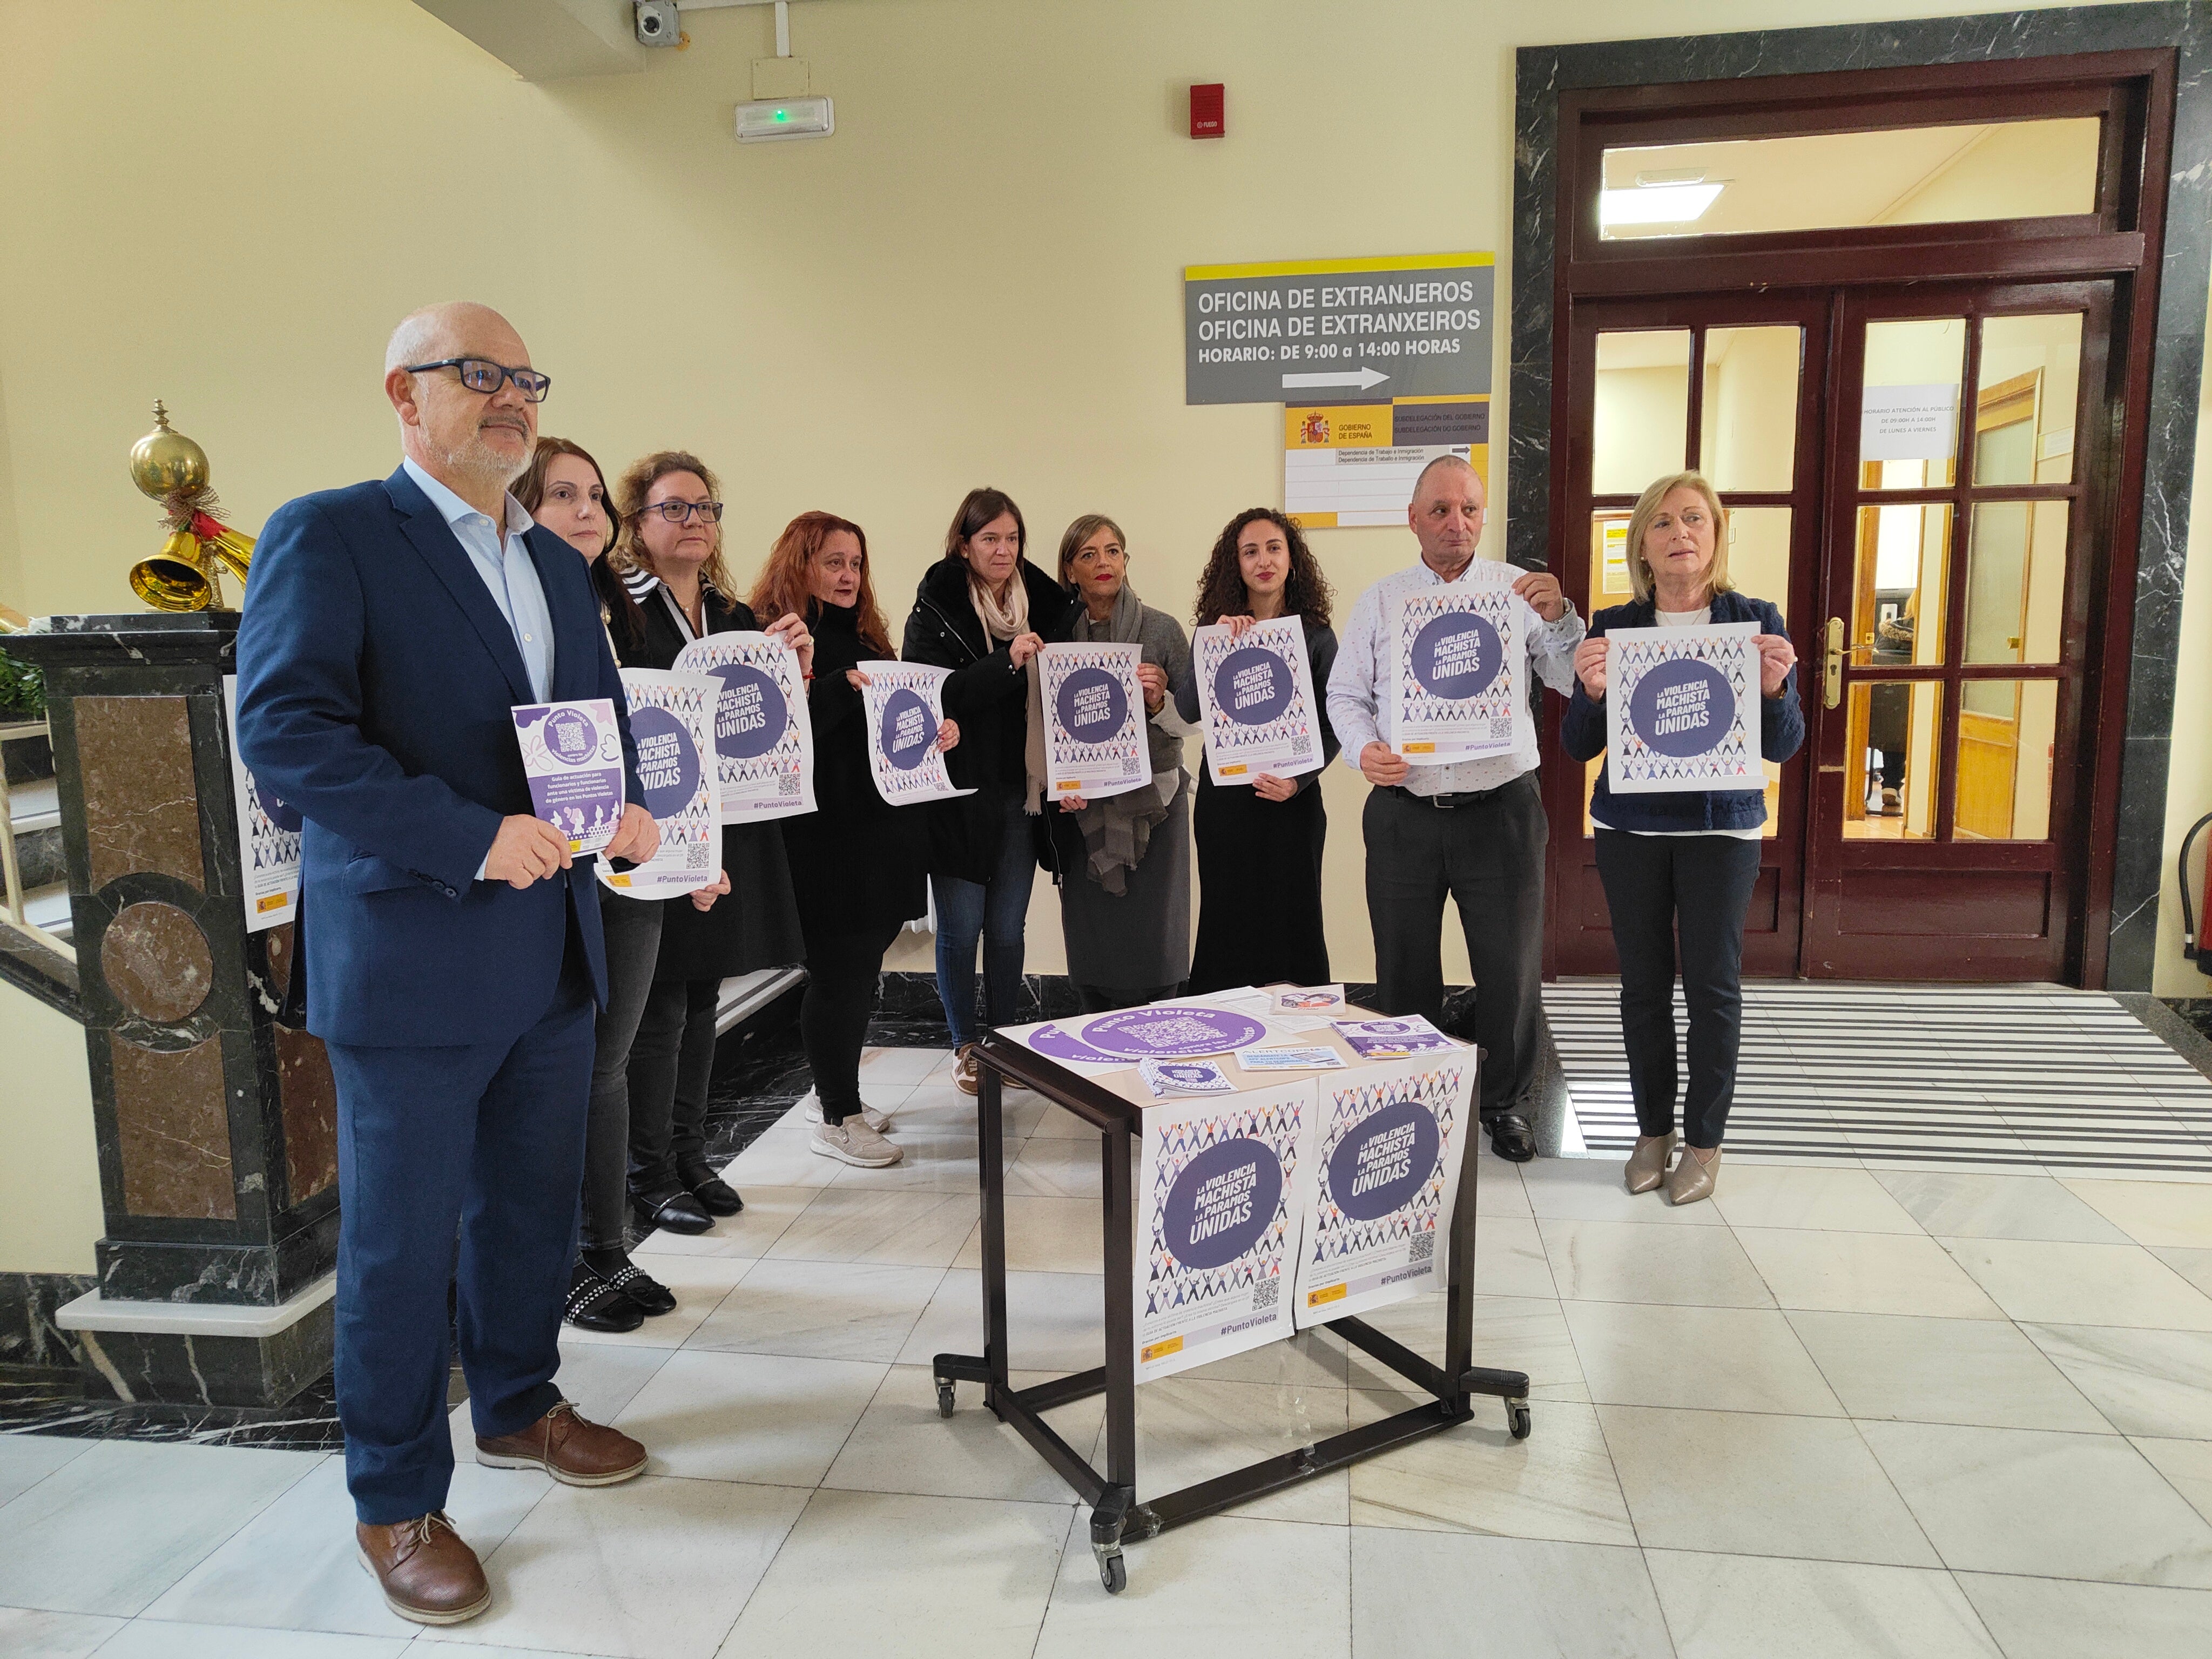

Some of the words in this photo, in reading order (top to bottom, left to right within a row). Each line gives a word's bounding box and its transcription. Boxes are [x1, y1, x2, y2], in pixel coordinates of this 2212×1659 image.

[1198, 290, 1282, 313] OFICINA
[1288, 288, 1315, 309] DE
[1322, 281, 1473, 307] EXTRANJEROS
[1198, 318, 1282, 341] OFICINA
[1288, 316, 1315, 336] DE
[1321, 309, 1480, 335] EXTRANXEIROS
[1199, 346, 1275, 363] HORARIO:
[1280, 345, 1300, 360] DE
[1305, 343, 1338, 359] 9:00
[1343, 346, 1352, 358] a
[1358, 341, 1400, 356] 14:00
[1406, 338, 1460, 355] HORAS
[1394, 414, 1441, 422] SUBDELEGACIÓN
[1348, 431, 1372, 439] ESPAÑA
[1394, 425, 1441, 433] SUBDELEGACIÓN
[1440, 629, 1479, 646] VIOLENCIA
[1434, 637, 1481, 658] MACHISTA
[1442, 648, 1477, 664] PARAMOS
[1237, 662, 1270, 678] VIOLENCIA
[1432, 657, 1480, 680] UNIDAS
[1233, 669, 1273, 690] MACHISTA
[1242, 679, 1271, 695] PARAMOS
[1664, 679, 1708, 697] VIOLENCIA
[719, 683, 759, 700] VIOLENCIA
[1074, 690, 1110, 707] MACHISTA
[1078, 683, 1109, 697] VIOLENCIA
[1235, 686, 1275, 710] UNIDAS
[1656, 689, 1710, 710] MACHISTA
[717, 691, 763, 713] MACHISTA
[1081, 700, 1108, 713] PARAMOS
[1666, 701, 1706, 718] PARAMOS
[548, 712, 565, 727] Punto
[567, 710, 589, 727] Violeta
[725, 703, 761, 721] PARAMOS
[899, 705, 921, 720] VIOLENCIA
[1074, 707, 1110, 727] UNIDAS
[716, 712, 766, 739] UNIDAS
[895, 713, 925, 732] MACHISTA
[900, 724, 923, 737] PARAMOS
[1655, 710, 1710, 736] UNIDAS
[640, 732, 678, 749] VIOLENCIA
[892, 731, 925, 753] UNIDAS
[1465, 742, 1510, 750] #PuntoVioleta
[551, 748, 576, 763] violencias
[577, 745, 596, 763] machistas
[1273, 758, 1313, 768] #PuntoVioleta
[640, 757, 678, 773] PARAMOS
[639, 767, 681, 791] NIDAS
[754, 800, 802, 809] #PuntoVioleta
[657, 874, 707, 882] #PuntoVioleta
[1091, 1015, 1136, 1033] Punto
[1137, 1009, 1216, 1019] Violeta
[1178, 1042, 1211, 1050] contra
[1215, 1027, 1255, 1050] machistas
[1360, 1142, 1368, 1151] LA
[1368, 1121, 1415, 1147] VIOLENCIA
[1357, 1132, 1415, 1165] MACHISTA
[1357, 1168, 1365, 1176] LA
[1366, 1148, 1410, 1173] PARAMOS
[1197, 1185, 1205, 1195] LA
[1206, 1161, 1256, 1191] VIOLENCIA
[1352, 1158, 1411, 1197] UNIDAS
[1194, 1173, 1257, 1211] MACHISTA
[1195, 1213, 1203, 1223] LA
[1204, 1190, 1251, 1218] PARAMOS
[1189, 1201, 1253, 1245] UNIDAS
[1381, 1266, 1432, 1285] #PuntoVioleta
[1220, 1313, 1277, 1336] #PuntoVioleta
